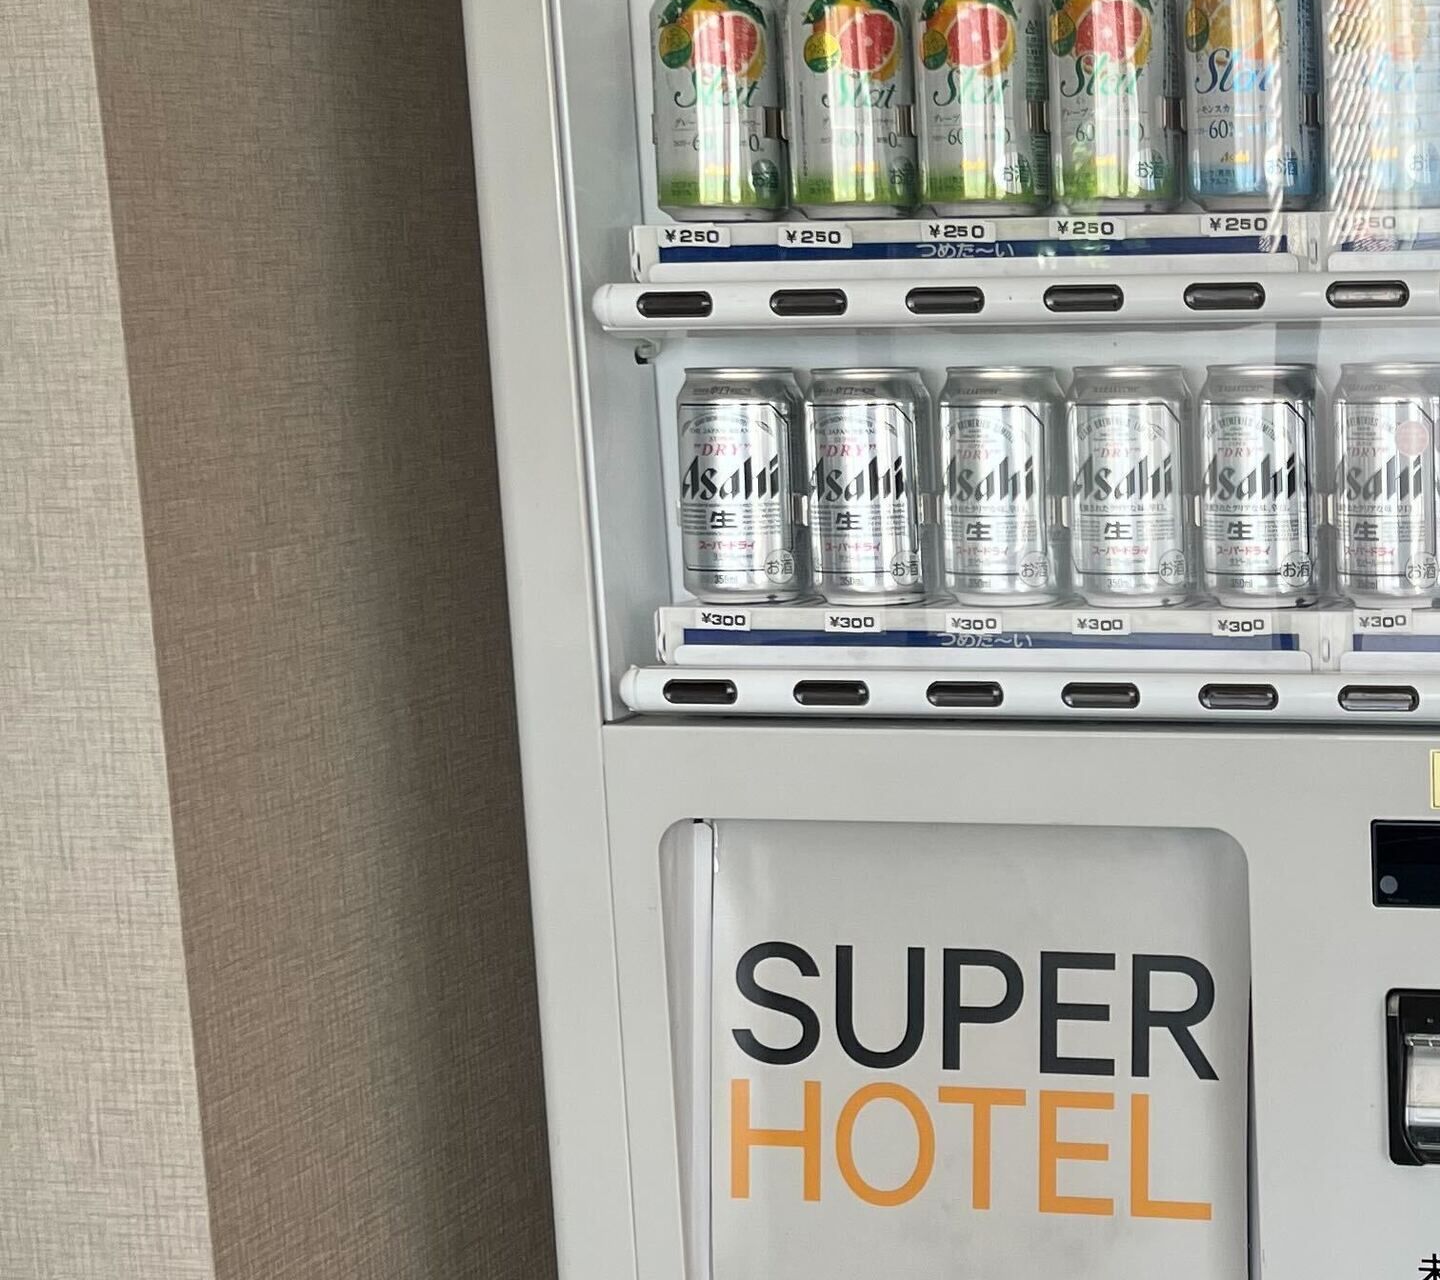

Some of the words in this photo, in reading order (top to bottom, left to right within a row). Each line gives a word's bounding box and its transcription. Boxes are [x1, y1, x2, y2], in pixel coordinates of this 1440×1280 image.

[1210, 120, 1228, 139] 60
[930, 224, 984, 238] ¥250
[1057, 221, 1114, 235] ¥250
[1210, 217, 1268, 231] ¥250
[666, 229, 720, 244] ¥250
[787, 230, 841, 244] ¥250
[683, 455, 780, 501] Asahi
[1073, 453, 1172, 502] Asahi
[710, 511, 737, 529] 生
[836, 512, 862, 530] 生
[966, 522, 991, 541] 生
[1104, 522, 1133, 540] 生
[1227, 521, 1254, 541] 生
[1353, 521, 1379, 541] 生
[699, 540, 755, 551] スーパードライ
[825, 542, 881, 553] スーパードライ
[956, 546, 1008, 556] スーパードライ
[1092, 546, 1148, 556] スーパードライ
[1217, 546, 1270, 556] スーパードライ
[1344, 546, 1395, 556] スーパードライ
[767, 555, 793, 575] お酒
[892, 558, 919, 577] お酒
[1021, 560, 1048, 578] お酒
[1161, 558, 1185, 577] お酒
[1283, 561, 1310, 578] お酒
[1408, 561, 1436, 580] お酒
[701, 613, 746, 626] ¥300
[830, 616, 874, 628] ¥300
[951, 617, 997, 631] ¥300
[1077, 618, 1123, 632] ¥300
[1218, 619, 1264, 632] ¥300
[1359, 614, 1406, 628] ¥300
[731, 941, 1220, 1081] SUPER
[730, 1079, 1212, 1221] HOTEL
